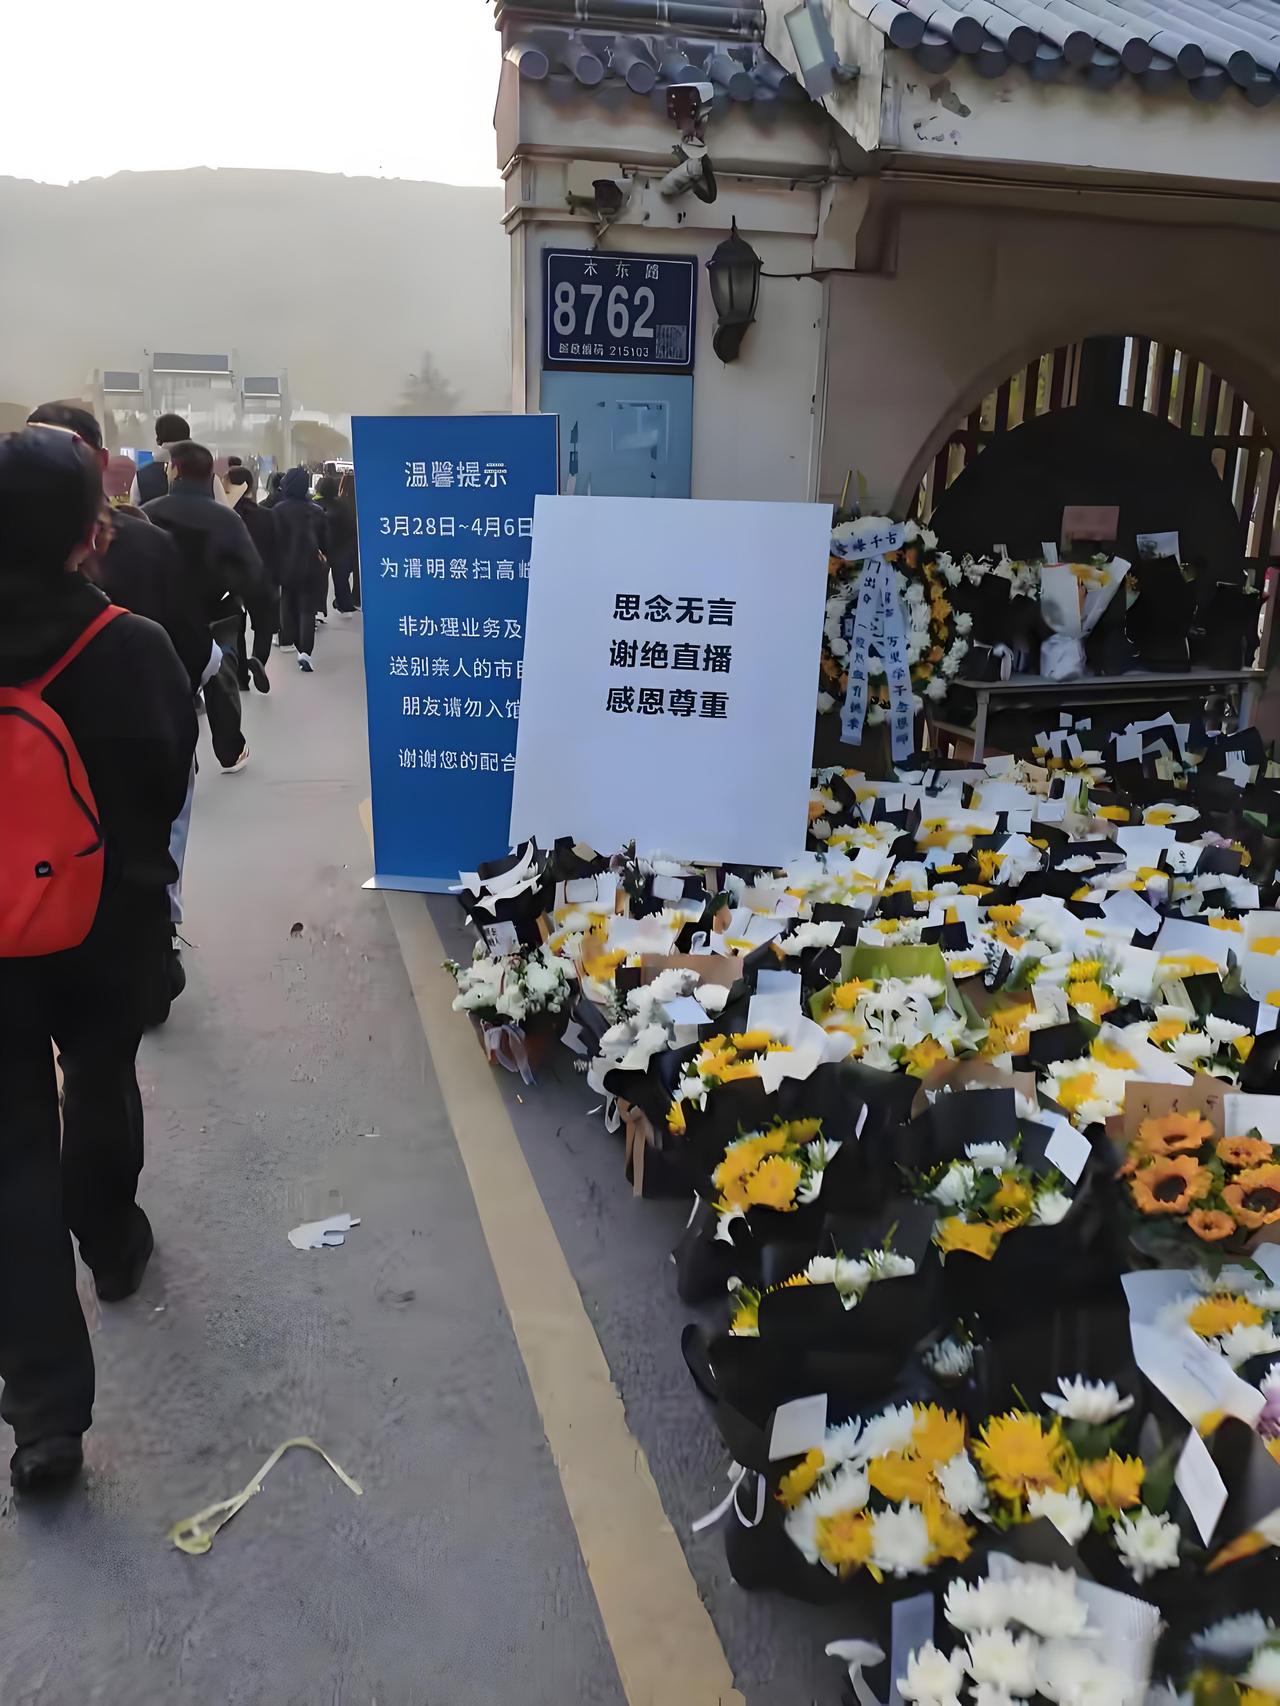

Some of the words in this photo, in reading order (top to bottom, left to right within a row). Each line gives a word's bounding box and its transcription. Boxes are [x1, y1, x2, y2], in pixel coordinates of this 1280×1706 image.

[553, 281, 655, 338] 8762
[609, 346, 649, 357] 215103
[405, 461, 507, 488] 温馨提示
[379, 516, 533, 538] 3月28日~4月6日
[613, 594, 736, 626] 思念无言
[399, 615, 523, 638] 非办理业务及
[609, 639, 732, 674] 谢绝直播
[606, 686, 729, 719] 感恩尊重
[398, 749, 516, 772] 谢谢您的配合
